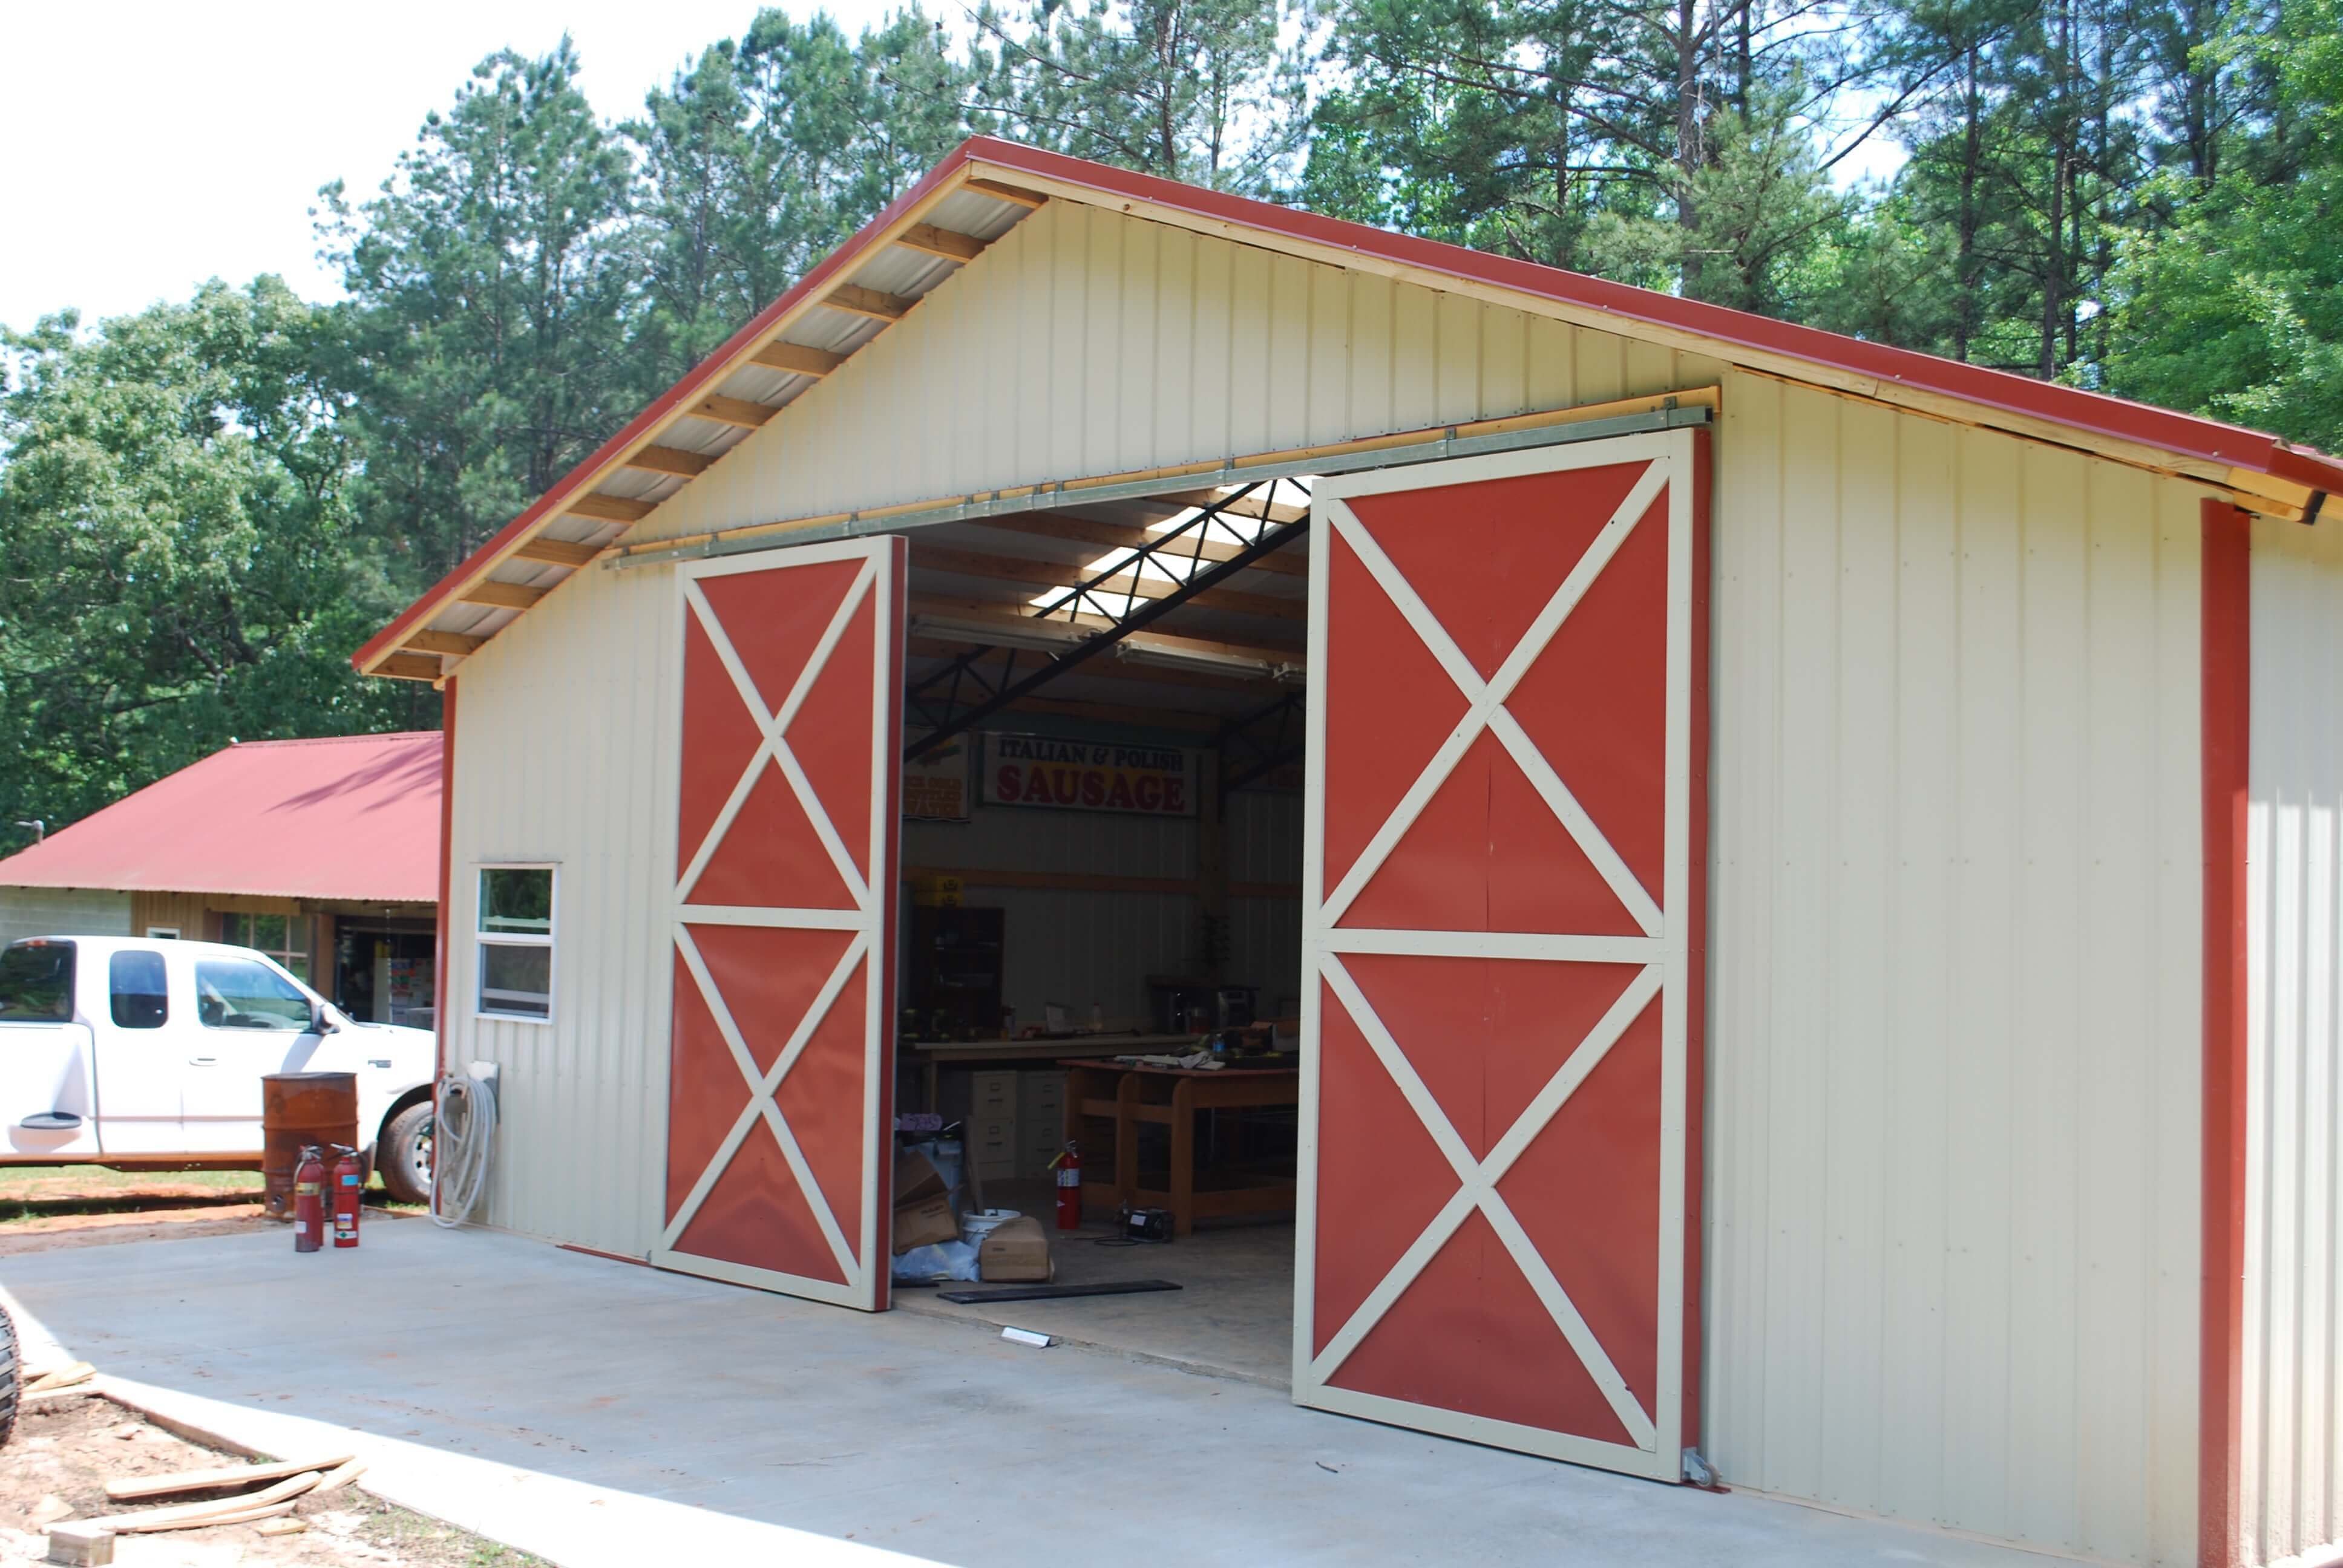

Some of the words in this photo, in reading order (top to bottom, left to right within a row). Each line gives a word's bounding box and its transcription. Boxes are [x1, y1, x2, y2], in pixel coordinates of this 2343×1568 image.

[999, 739, 1086, 763] ITALIAN
[1093, 747, 1109, 765] &
[1115, 750, 1184, 771] POLISH
[997, 764, 1185, 812] SAUSAGE
